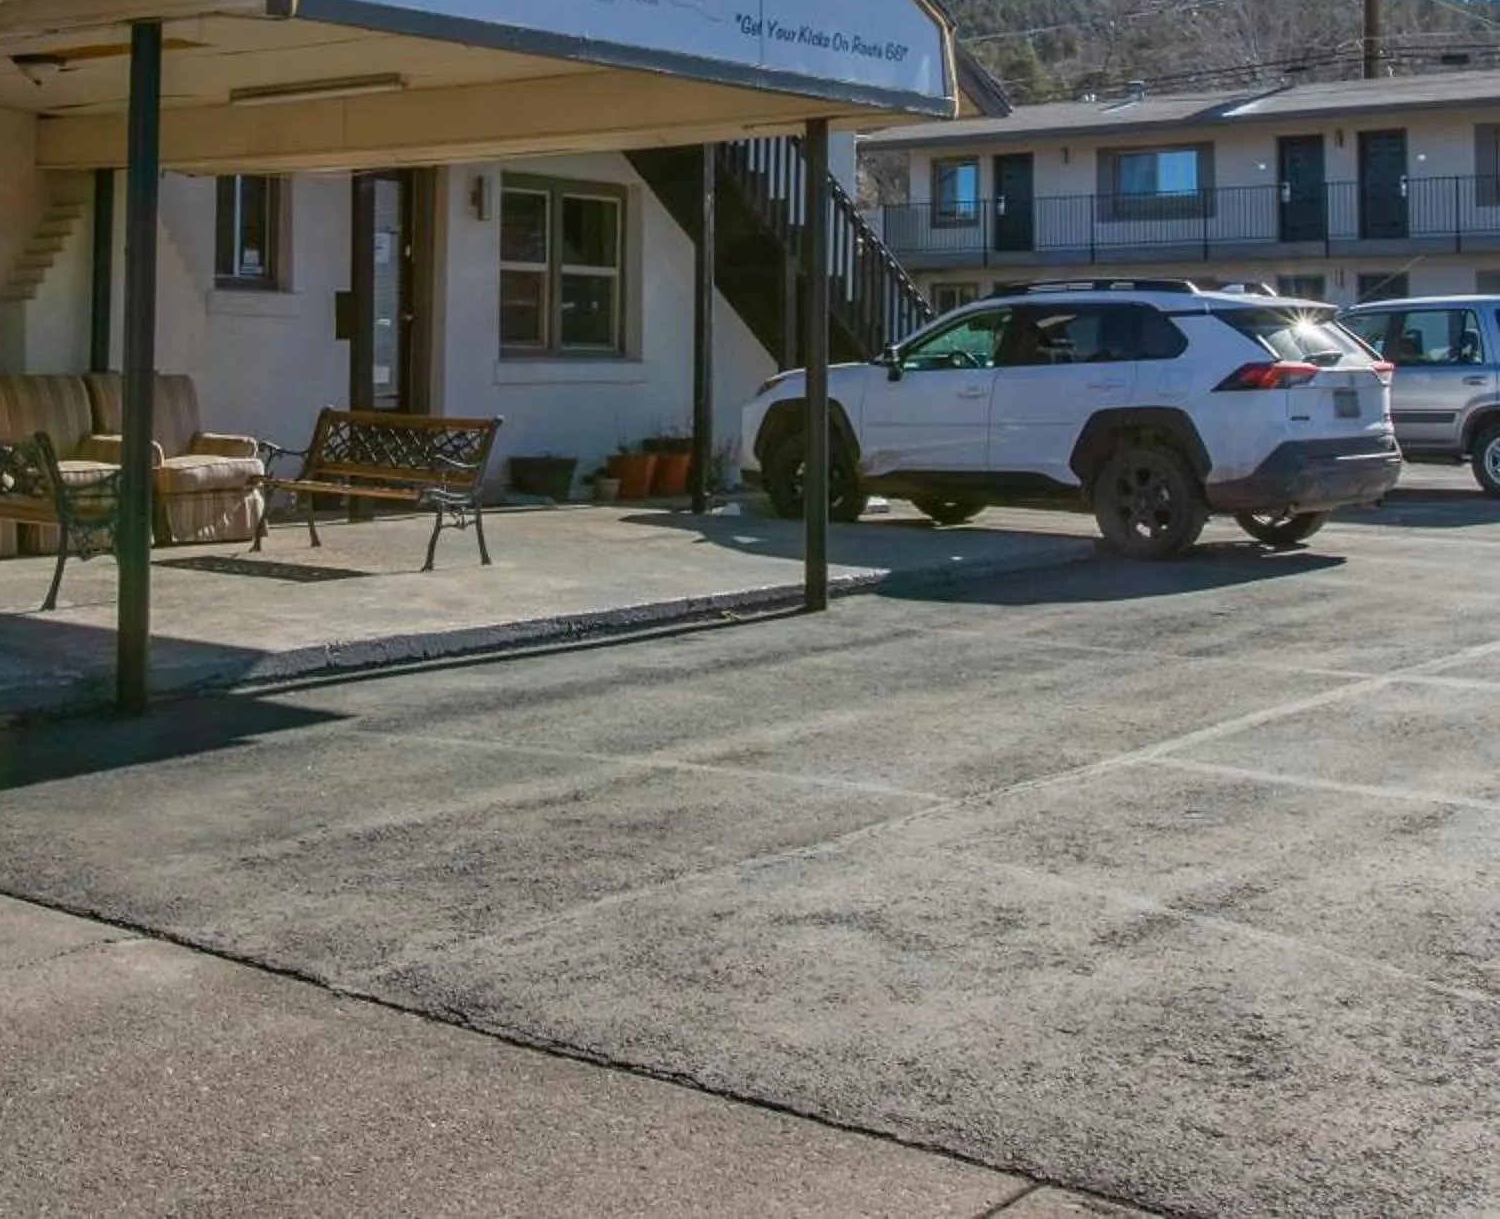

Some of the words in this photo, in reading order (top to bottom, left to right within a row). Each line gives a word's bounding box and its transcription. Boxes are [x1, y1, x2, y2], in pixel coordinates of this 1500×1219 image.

[767, 20, 796, 42] Your
[832, 32, 849, 53] On
[851, 36, 883, 59] Route
